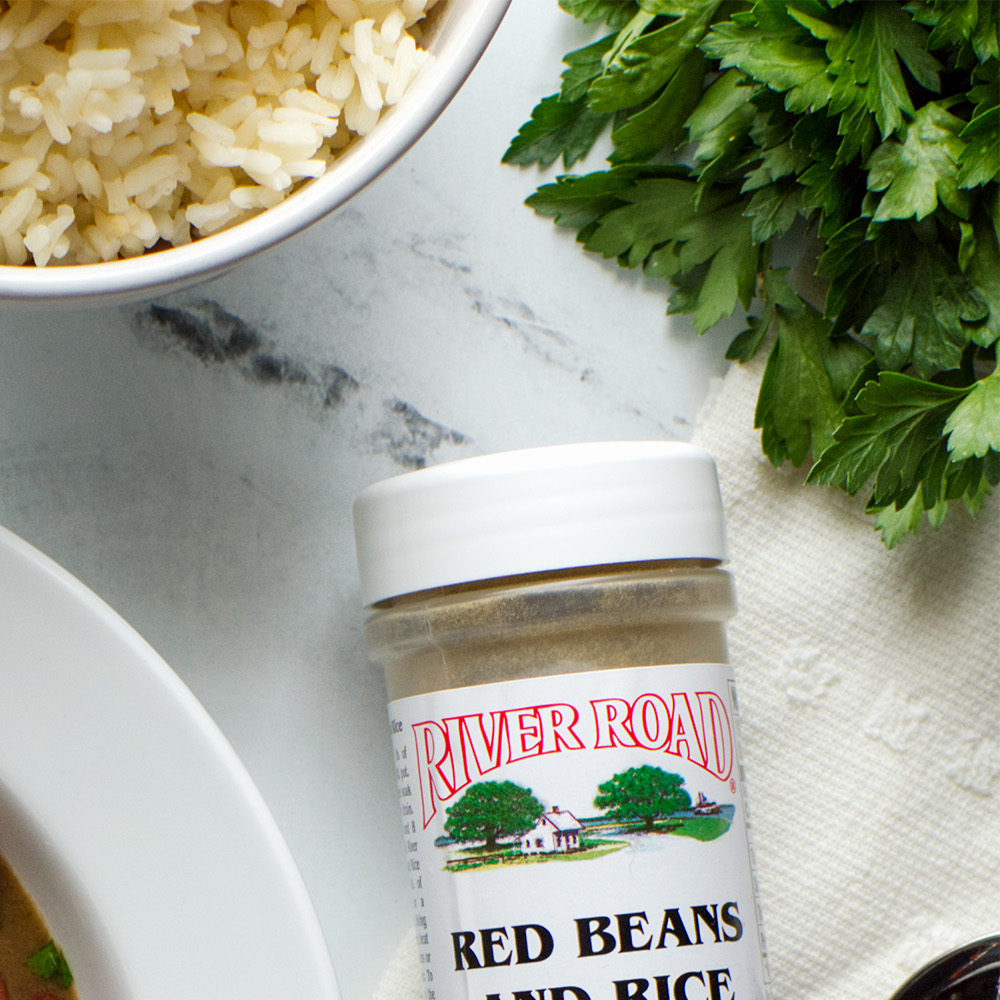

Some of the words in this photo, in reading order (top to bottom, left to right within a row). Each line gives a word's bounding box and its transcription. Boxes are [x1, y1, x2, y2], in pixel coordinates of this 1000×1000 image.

[412, 703, 584, 830] RIVER
[590, 691, 734, 782] ROAD
[451, 923, 555, 971] RED
[574, 901, 744, 958] BEANS
